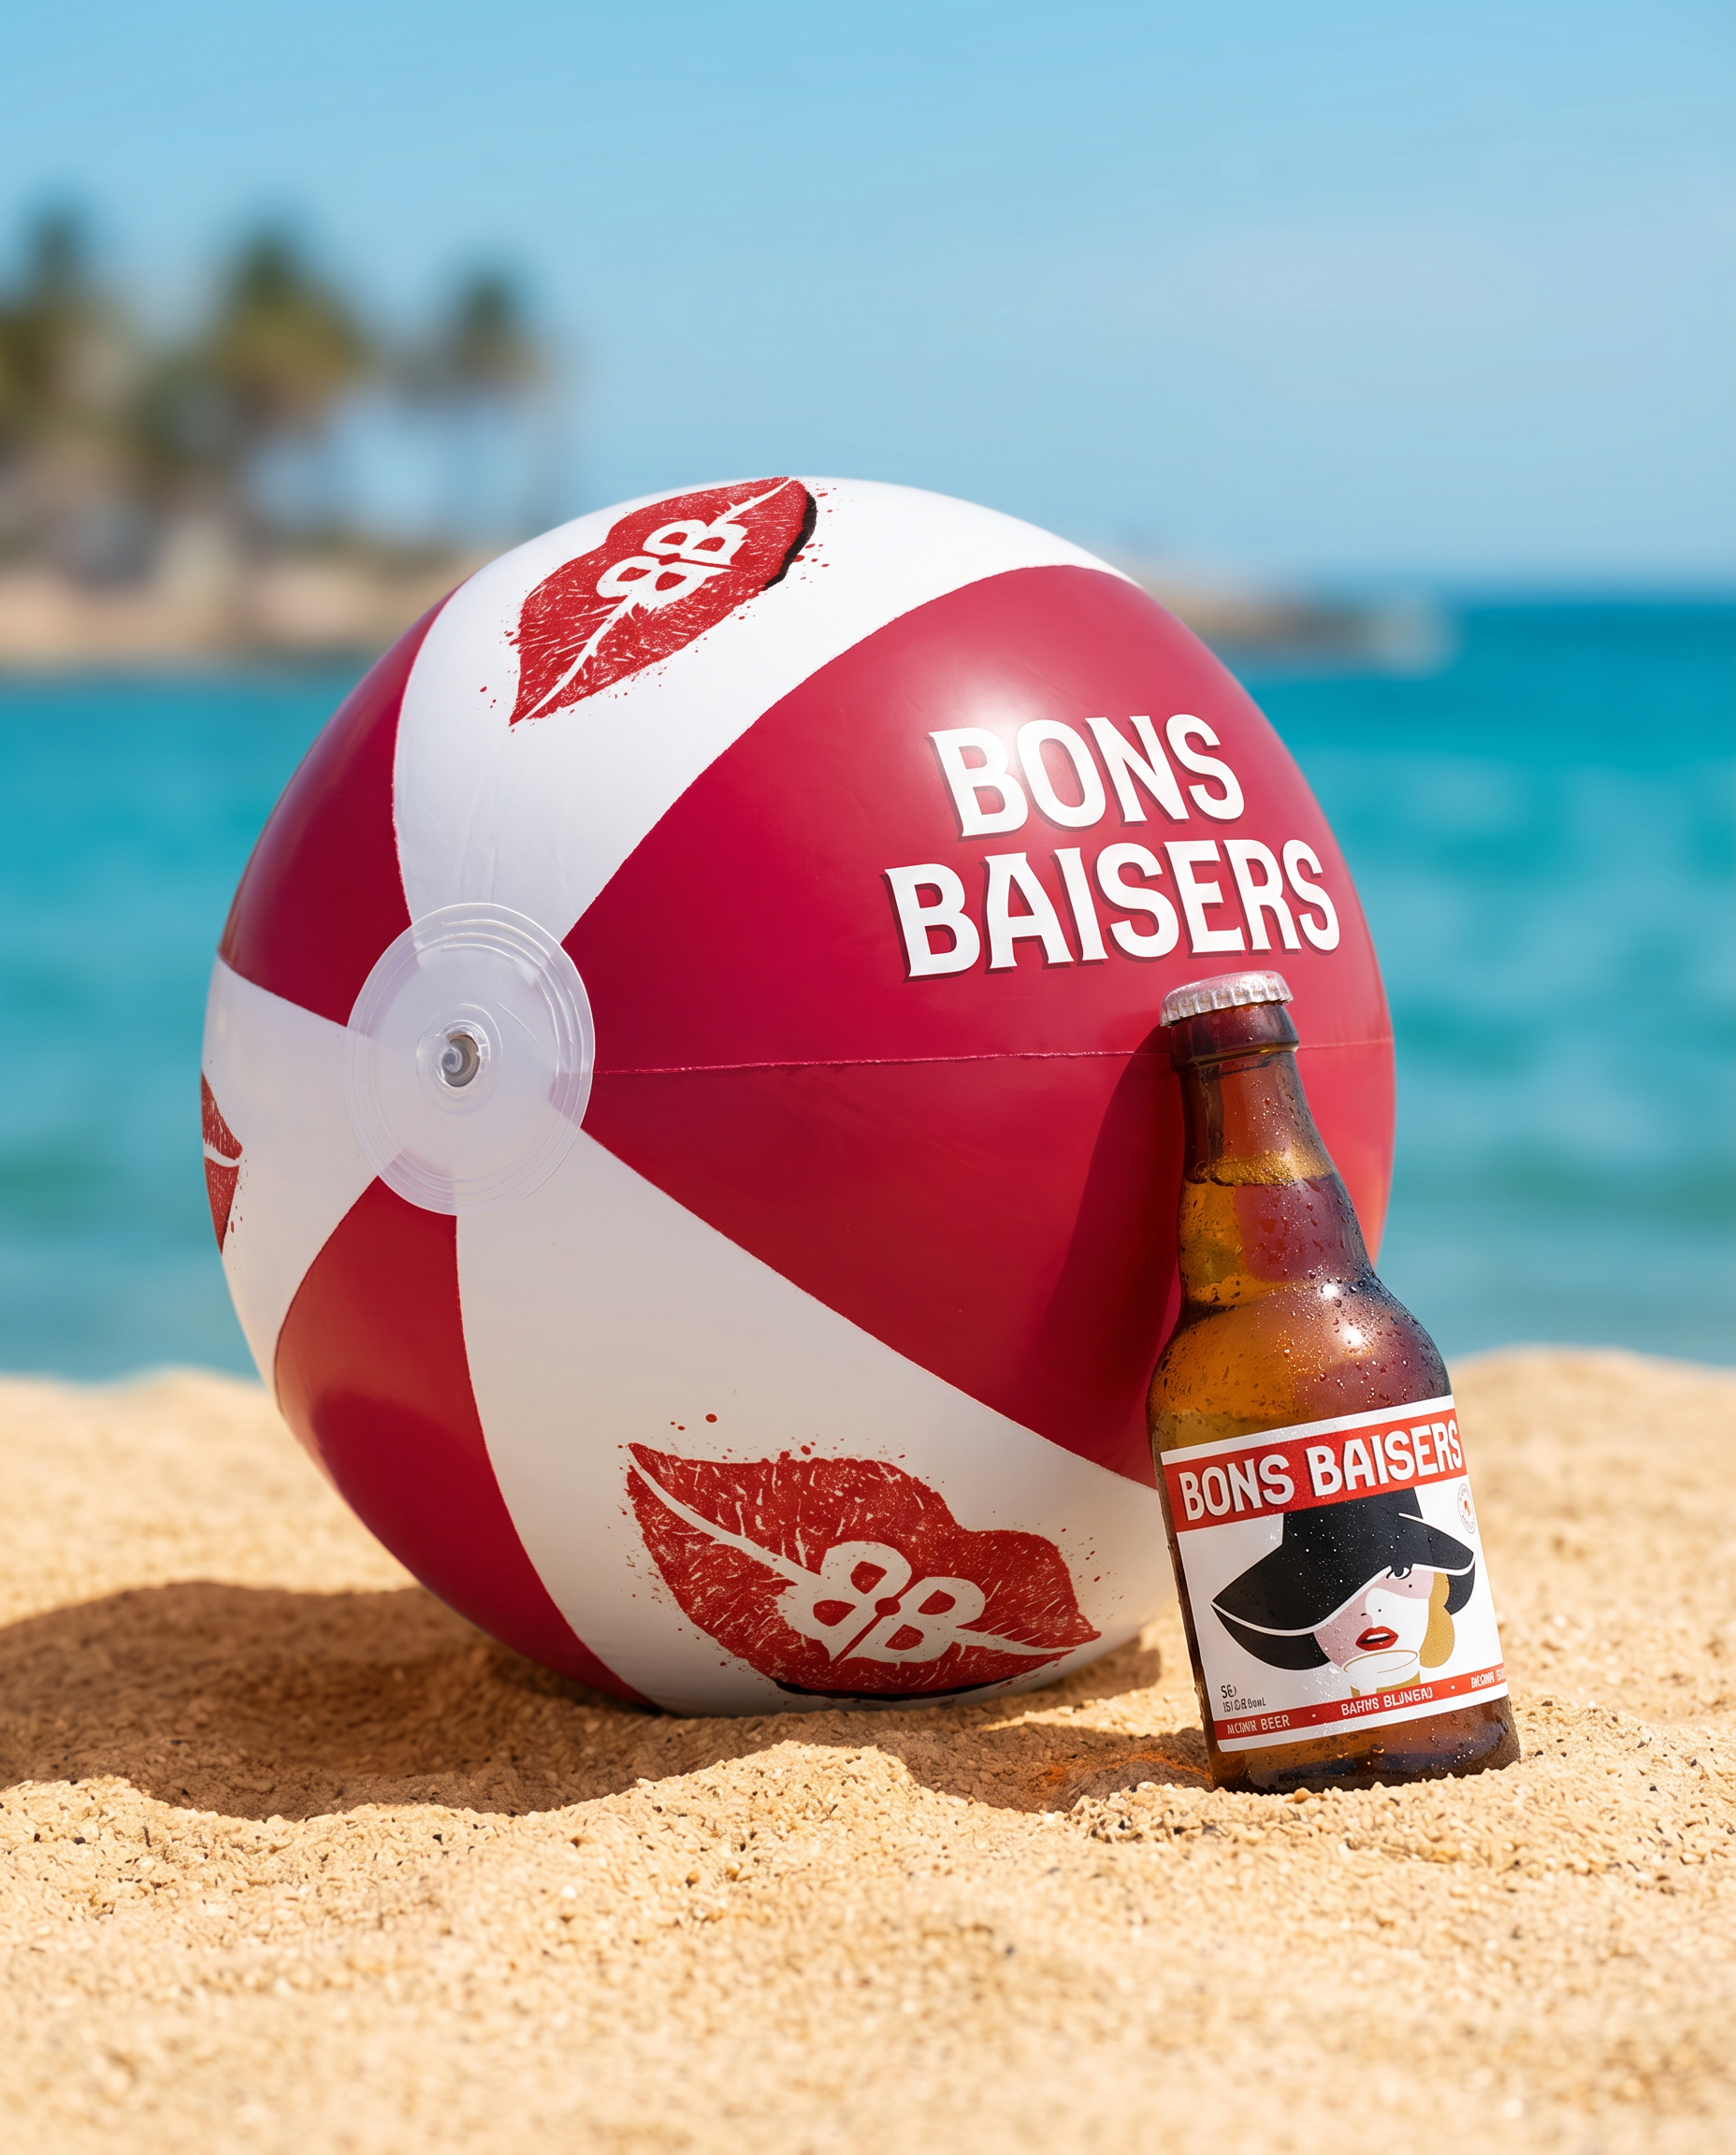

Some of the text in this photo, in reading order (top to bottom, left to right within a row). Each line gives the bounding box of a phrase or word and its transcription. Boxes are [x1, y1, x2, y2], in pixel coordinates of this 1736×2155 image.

[928, 714, 1245, 838] BONS
[883, 838, 1340, 977] BAISERS
[1179, 1419, 1463, 1521] BONS BAISERS
[1260, 1714, 1291, 1730] BEER
